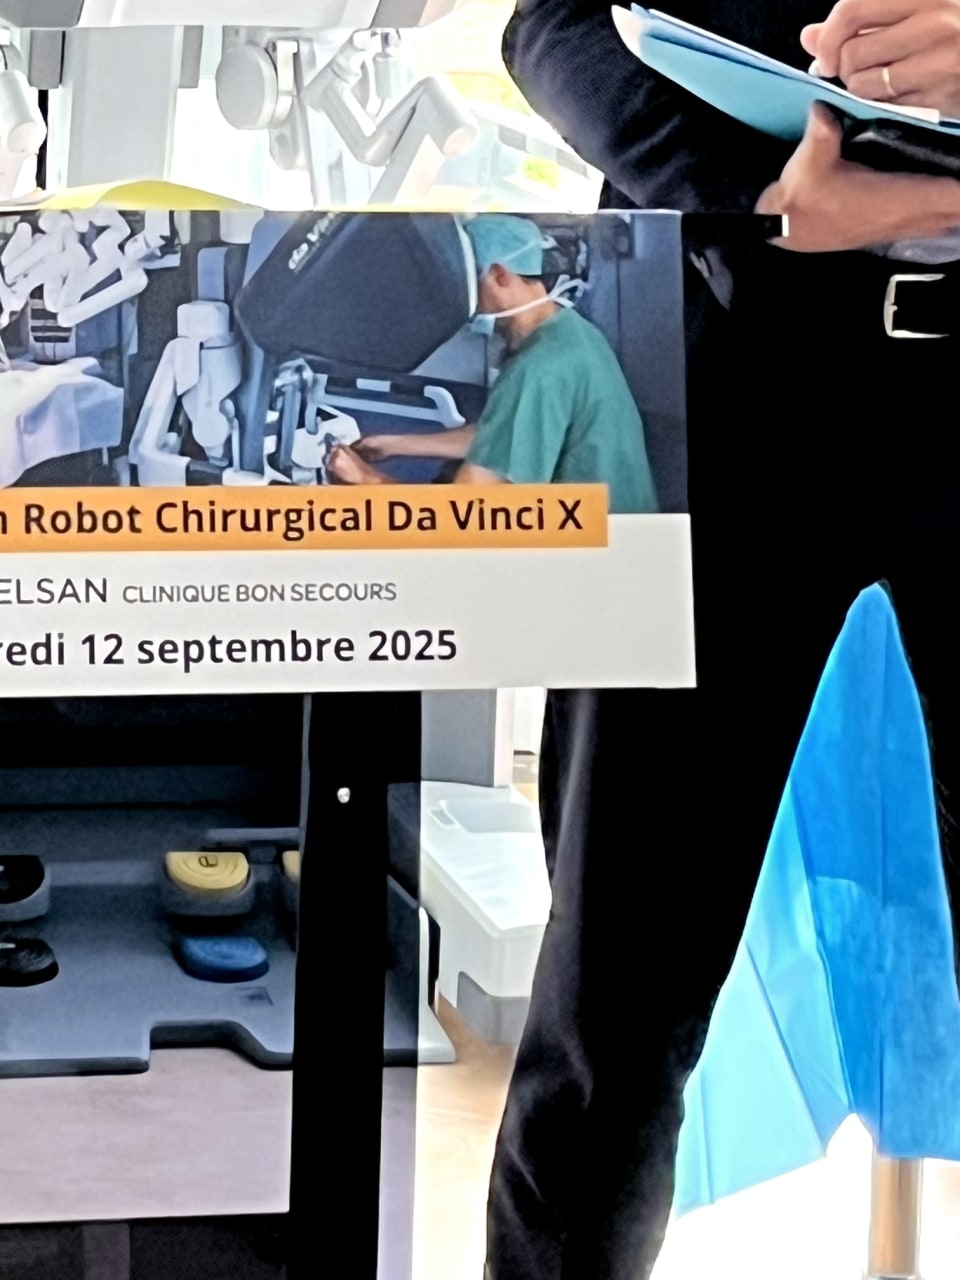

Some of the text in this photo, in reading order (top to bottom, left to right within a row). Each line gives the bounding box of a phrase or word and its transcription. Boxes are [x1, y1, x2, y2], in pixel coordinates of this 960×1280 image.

[25, 502, 142, 535] Robot
[156, 499, 372, 542] Chirurgical
[388, 500, 437, 532] Da
[449, 499, 544, 531] Vinci
[558, 500, 583, 530] X
[122, 584, 230, 604] CLINIQUE
[236, 584, 285, 602] BON
[291, 582, 397, 602] SECOURS
[81, 633, 124, 665] 12
[137, 629, 355, 674] septembre
[368, 629, 457, 661] 2025
